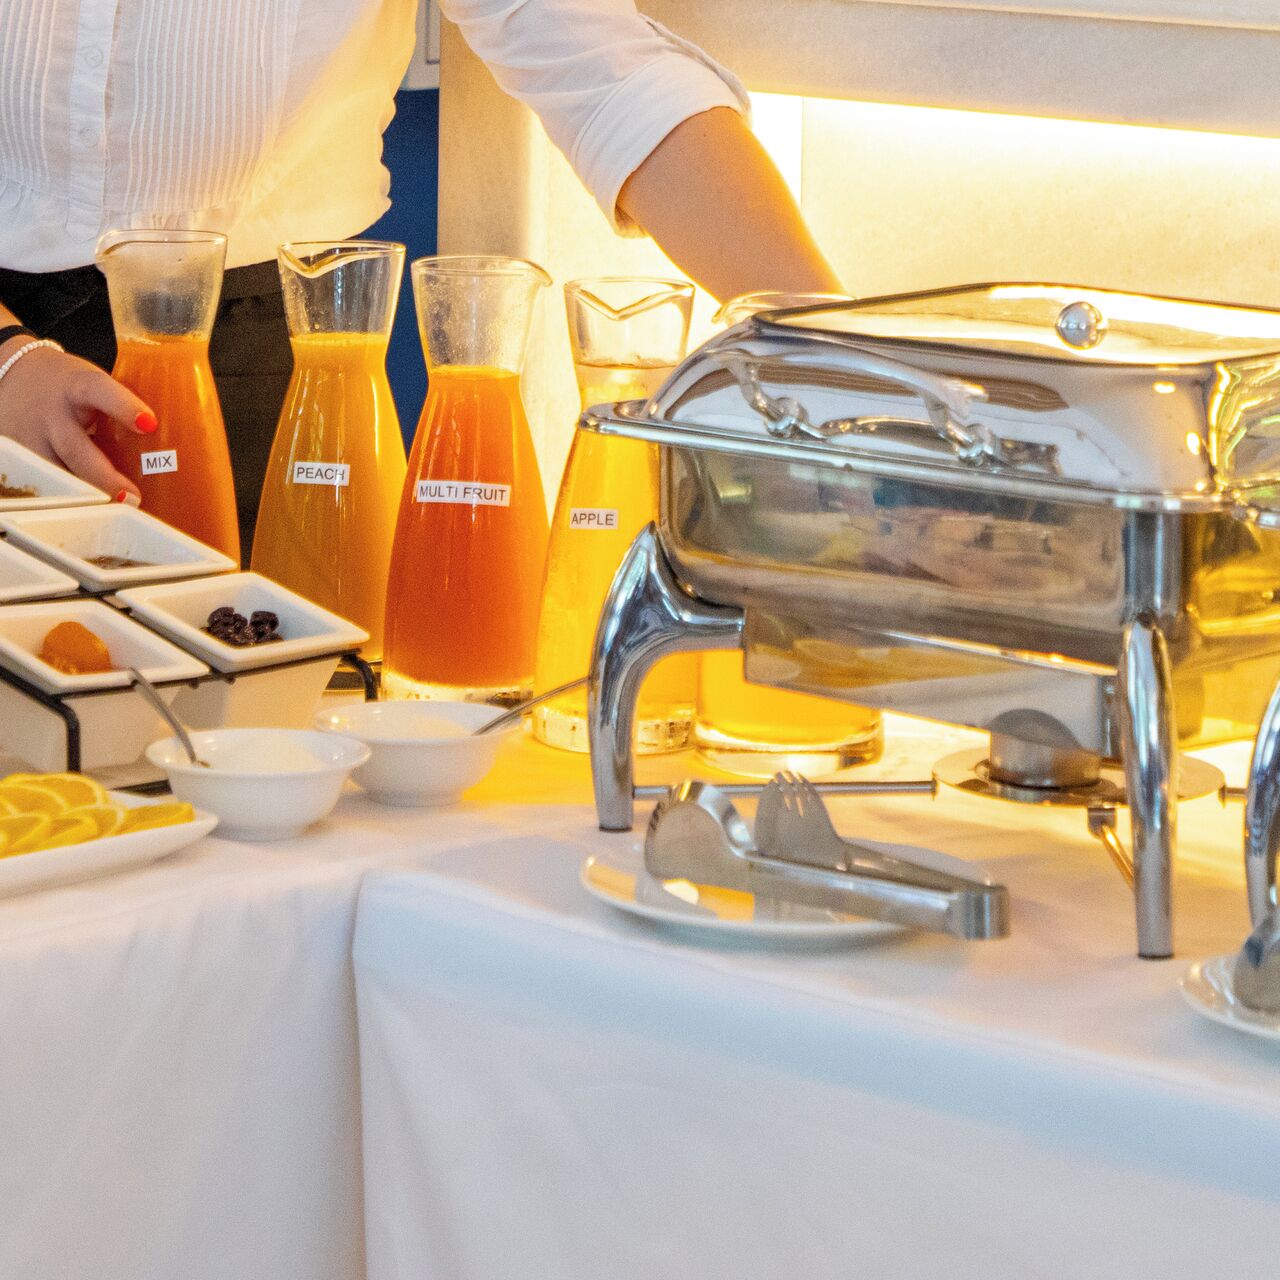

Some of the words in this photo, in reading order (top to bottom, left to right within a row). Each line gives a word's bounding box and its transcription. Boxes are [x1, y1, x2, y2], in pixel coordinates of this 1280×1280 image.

[146, 455, 172, 470] MIX
[296, 466, 345, 481] PEACH
[419, 485, 458, 499] MULTI
[463, 488, 507, 502] FRUIT
[571, 512, 614, 526] APPLE
